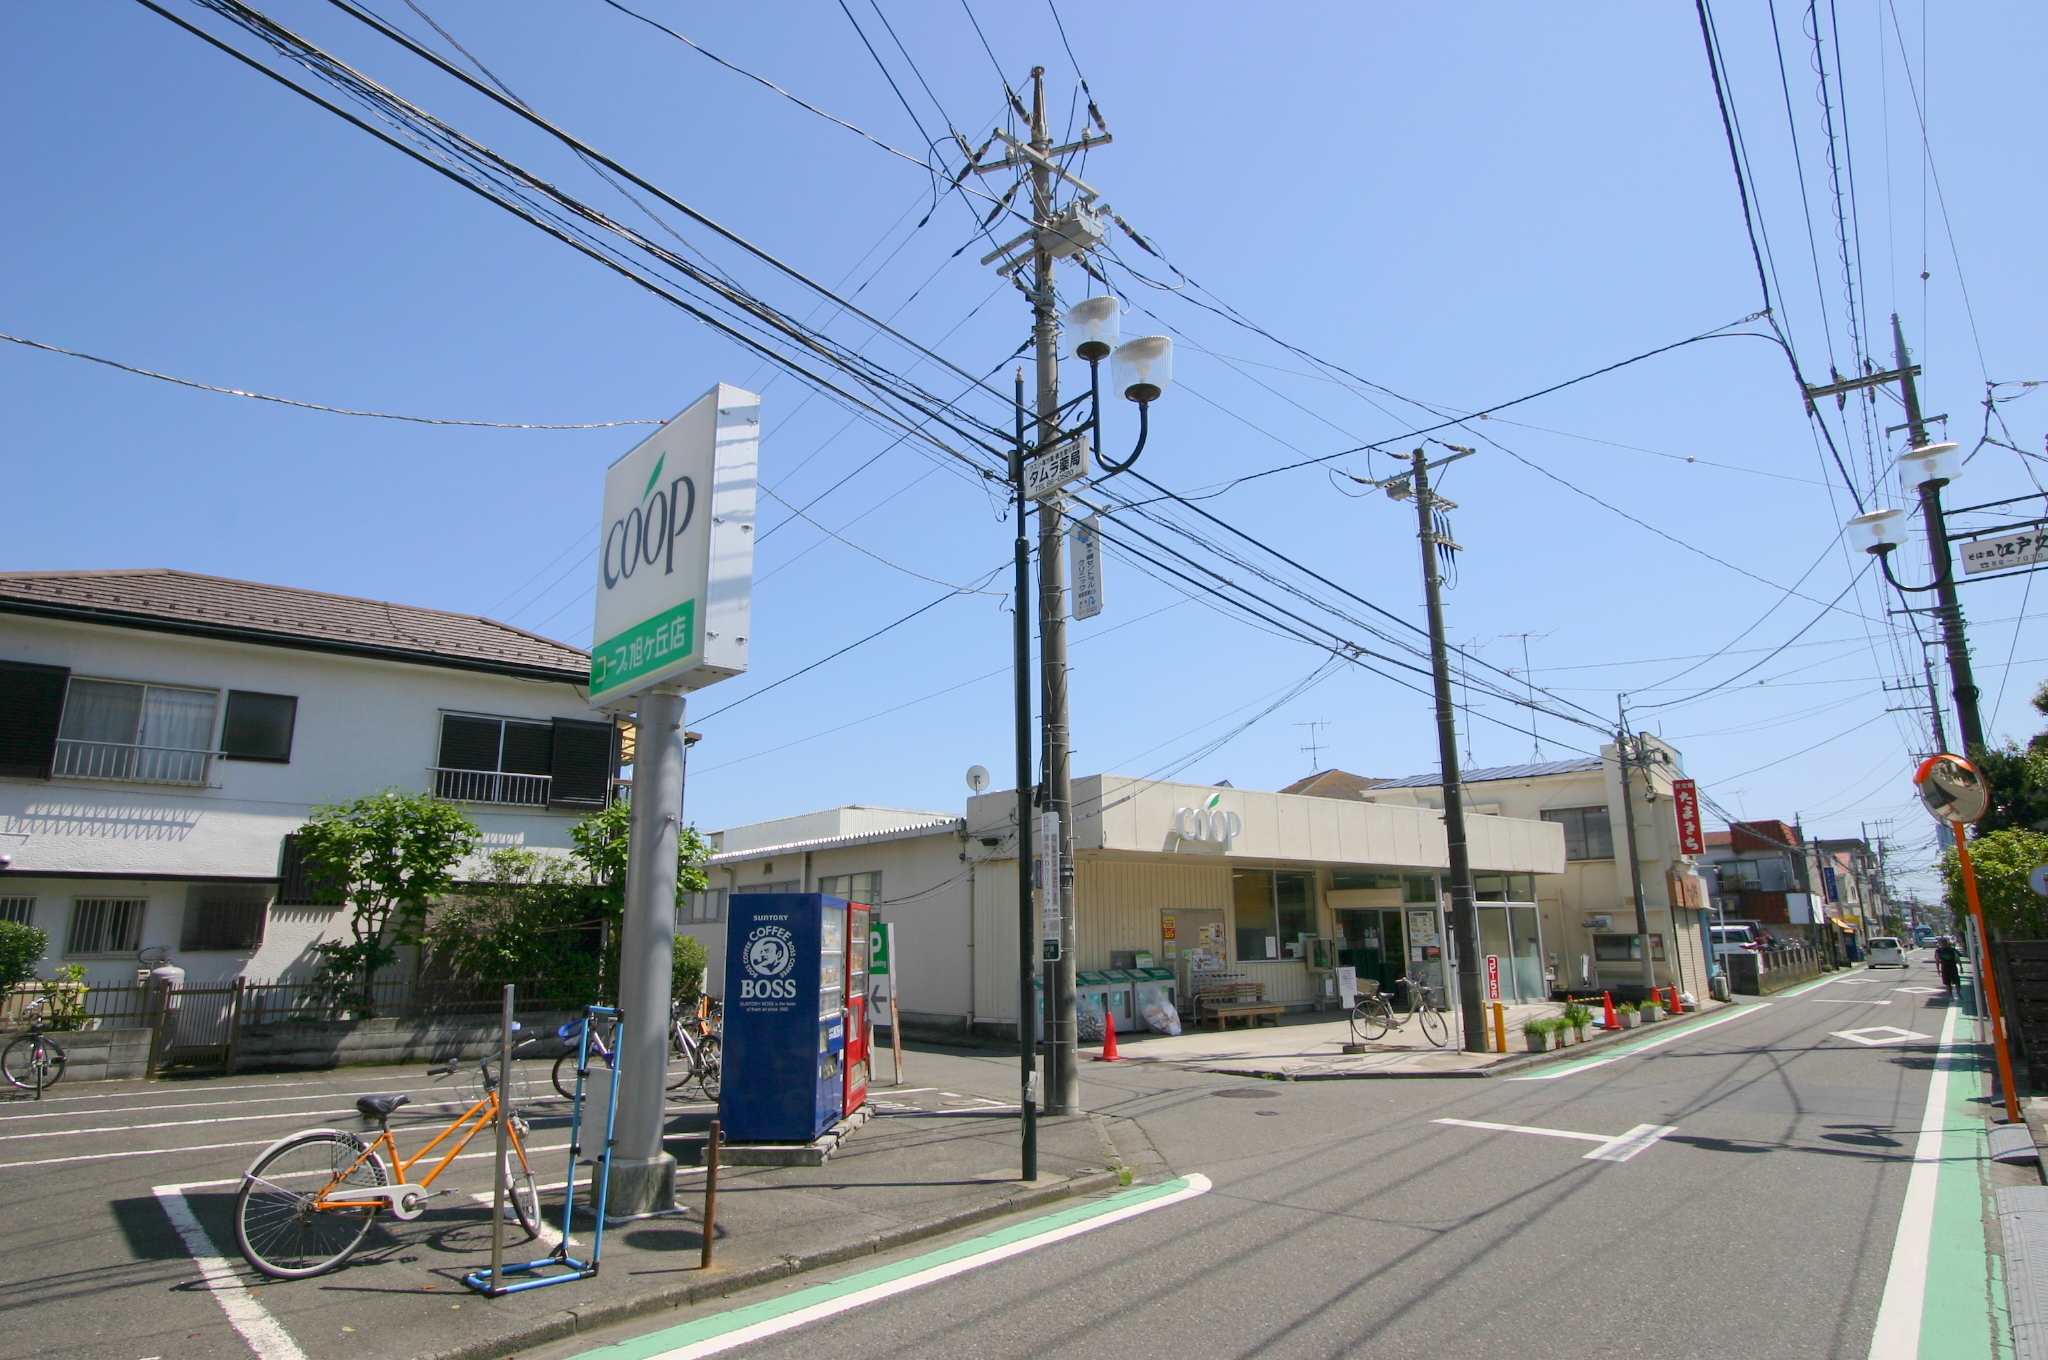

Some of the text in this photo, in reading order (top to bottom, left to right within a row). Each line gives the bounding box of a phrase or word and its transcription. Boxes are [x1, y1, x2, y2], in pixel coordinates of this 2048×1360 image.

[1029, 449, 1080, 487] タムラ薬局
[1035, 483, 1046, 492] TEL
[749, 925, 792, 941] COFFEE
[740, 979, 797, 999] BOSS
